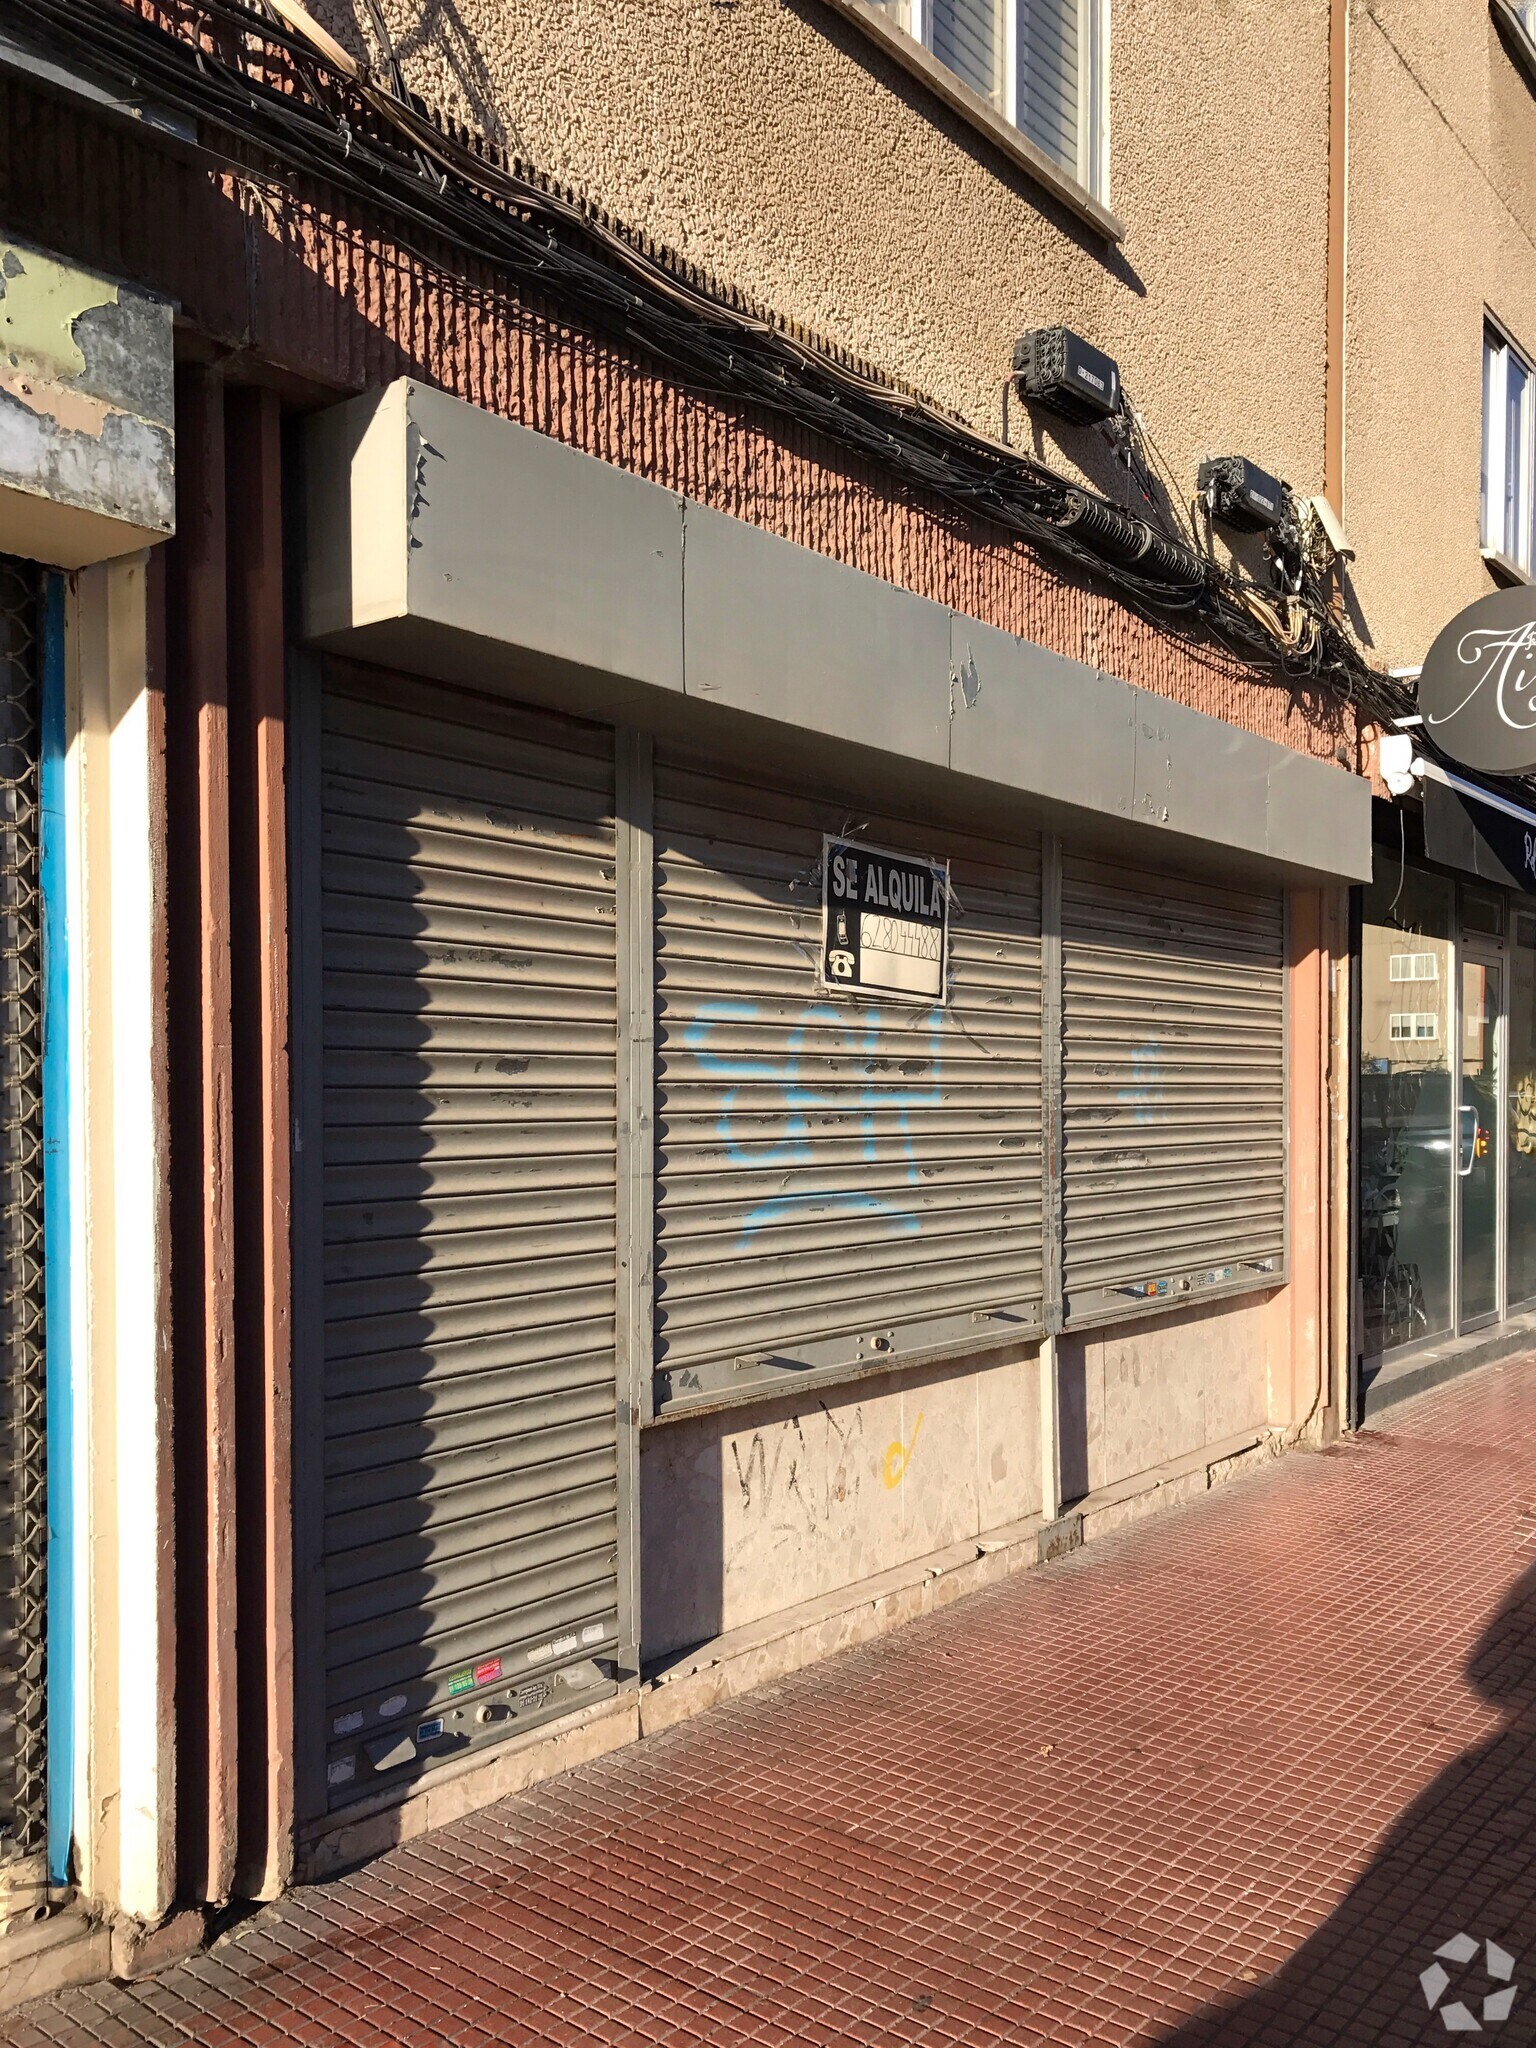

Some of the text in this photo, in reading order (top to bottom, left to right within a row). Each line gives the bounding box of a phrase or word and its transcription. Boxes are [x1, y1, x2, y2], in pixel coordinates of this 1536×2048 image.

[833, 855, 941, 918] SE ALQUILA
[861, 913, 939, 960] 628044488
